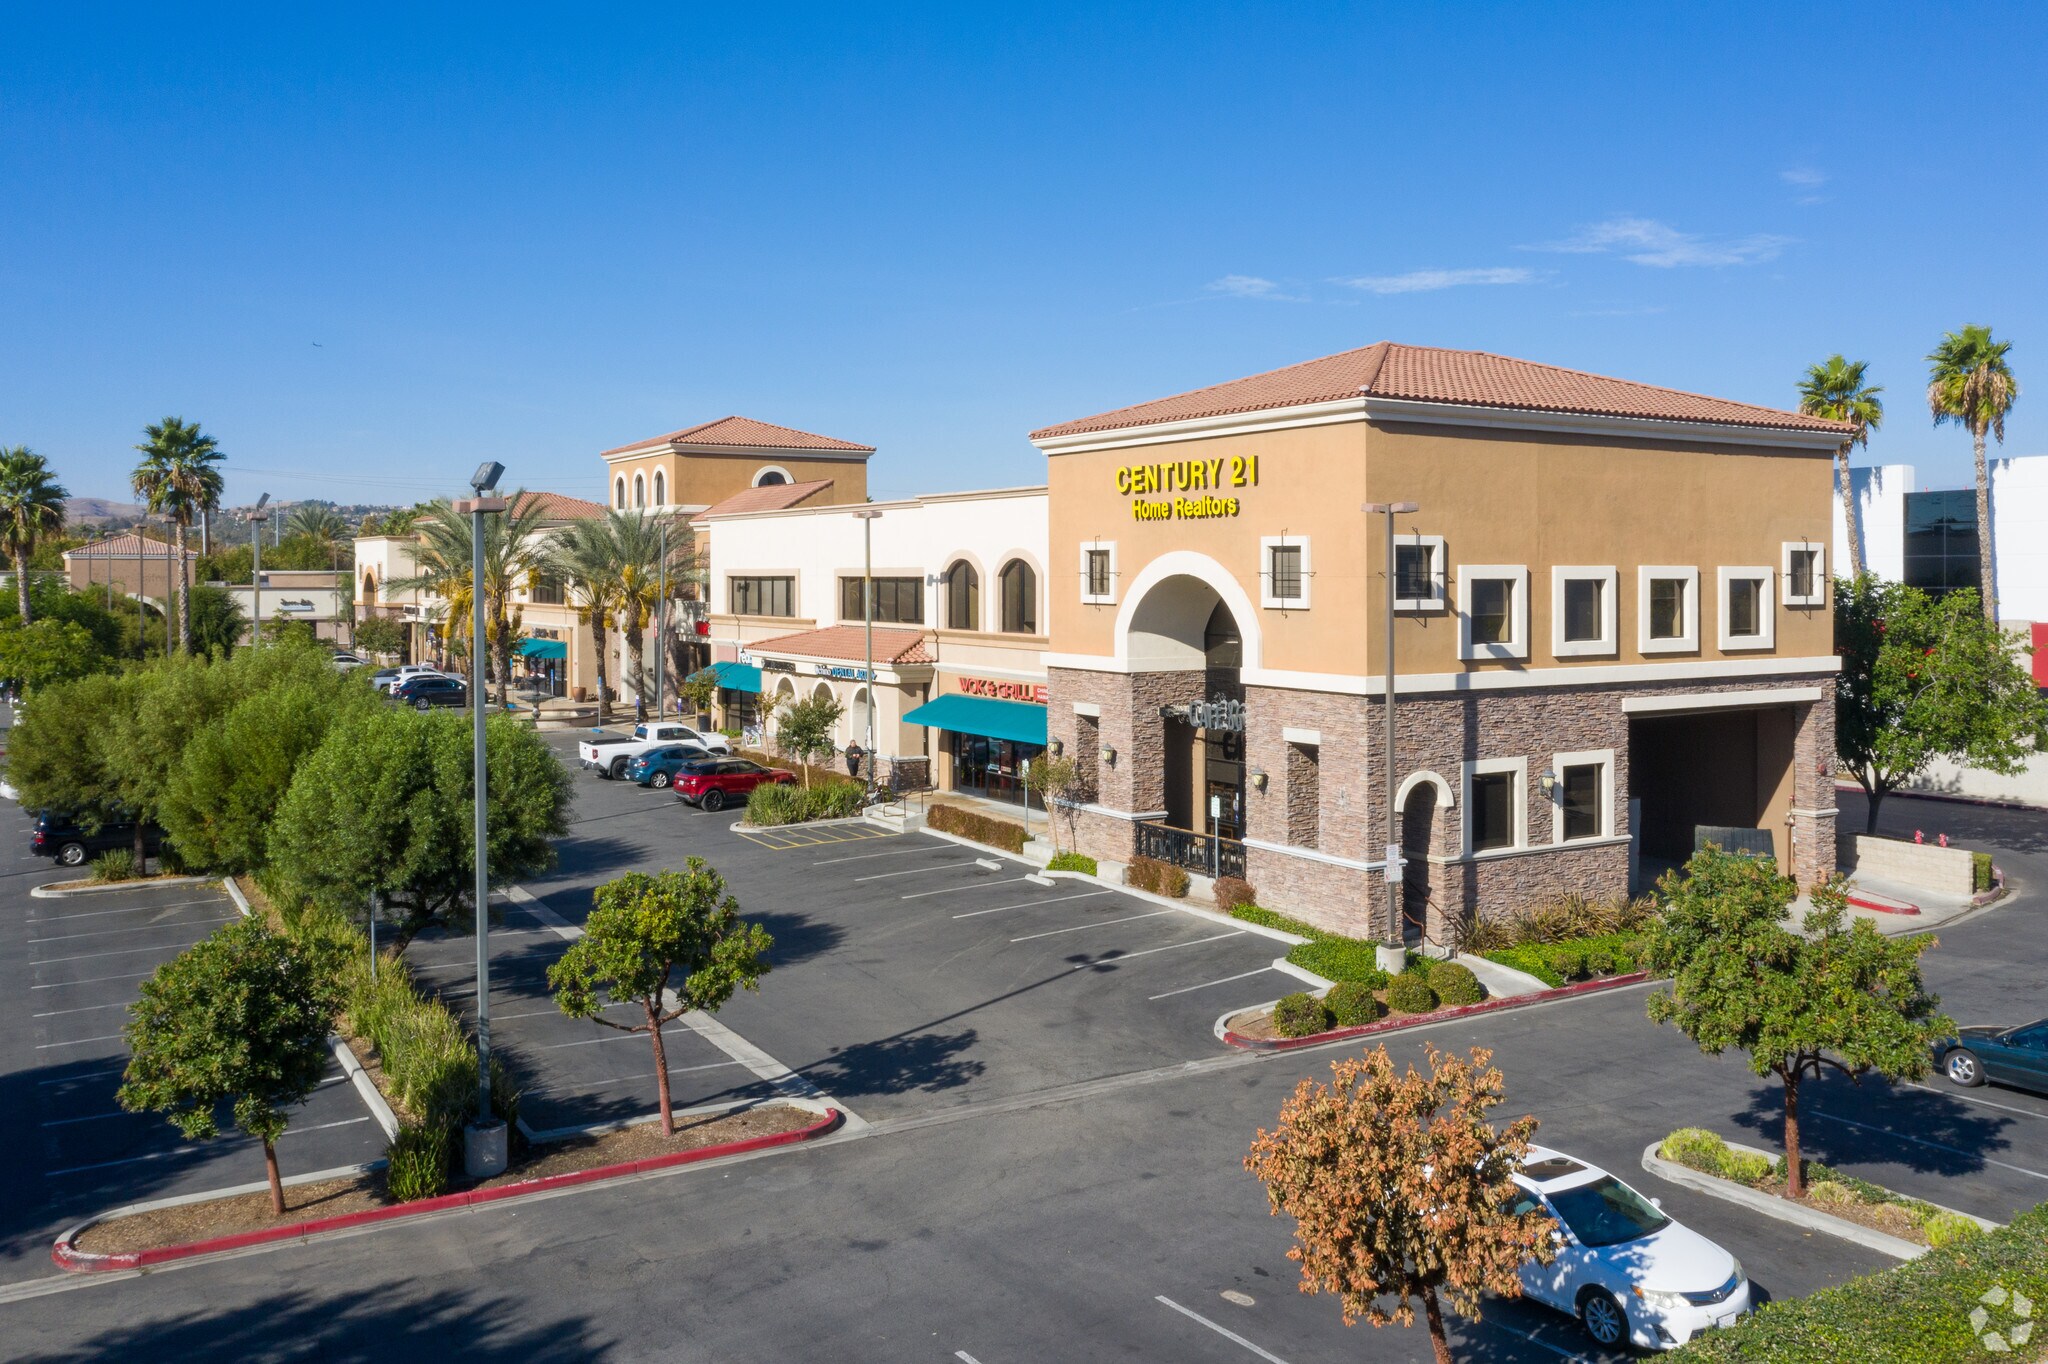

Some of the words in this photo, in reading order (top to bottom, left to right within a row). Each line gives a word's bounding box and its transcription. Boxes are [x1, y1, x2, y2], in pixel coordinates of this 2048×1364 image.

[1115, 459, 1223, 494] CENTURY
[1230, 455, 1257, 486] 21
[1132, 499, 1170, 520] Home
[1174, 496, 1238, 518] Realtors
[959, 676, 986, 696] WOK
[986, 679, 997, 698] &
[998, 681, 1032, 702] GRILL
